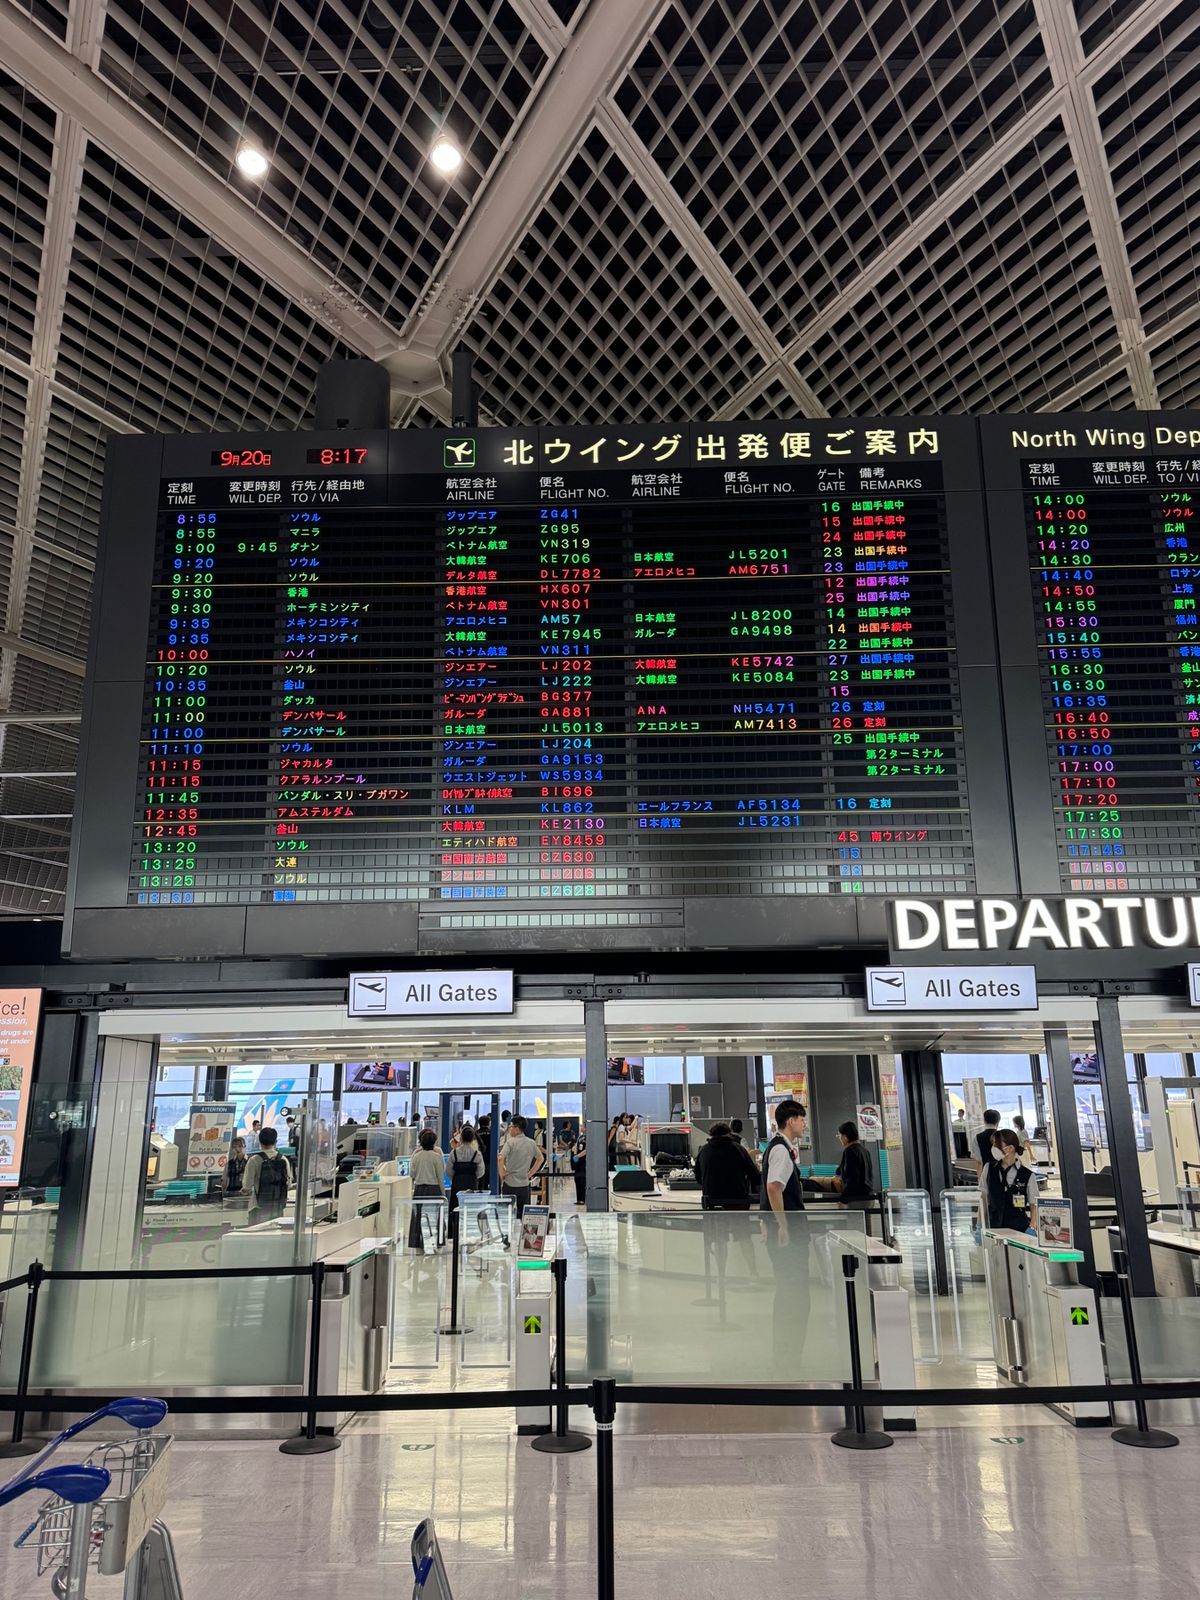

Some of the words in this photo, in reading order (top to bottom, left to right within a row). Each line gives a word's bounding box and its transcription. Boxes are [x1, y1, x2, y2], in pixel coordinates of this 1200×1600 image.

[1012, 430, 1075, 447] North
[1086, 429, 1144, 449] Wing
[504, 434, 682, 465] 北ウイング
[697, 428, 939, 461] 出発便ご案内
[221, 451, 271, 466] 9月20日
[321, 449, 367, 464] 8:17
[1029, 463, 1054, 473] 定刻
[1092, 461, 1144, 472] 変更時刻
[724, 472, 749, 482] 便名
[818, 469, 844, 479] ゲート
[860, 468, 884, 478] 備考
[1158, 474, 1175, 482] TO
[446, 478, 497, 488] 航空会社
[540, 477, 564, 487] 便名
[632, 473, 682, 485] 航空会社
[861, 479, 921, 489] REMARKS
[1030, 476, 1060, 485] TIME
[1094, 475, 1121, 484] WILL
[1124, 475, 1148, 483] DEP.
[168, 483, 194, 493] 定刻
[230, 481, 280, 492] 変更時刻
[632, 487, 680, 496] AIRLINE
[725, 484, 769, 494] FLIGHT
[774, 483, 794, 493] NO.
[819, 482, 845, 491] GATE
[229, 492, 256, 503] WILL
[259, 492, 281, 503] DEP.
[292, 493, 308, 502] TO
[319, 492, 339, 501] VIA
[447, 491, 494, 500] AIRLINE
[541, 489, 584, 498] FLIGHT
[588, 488, 608, 498] NO.
[1161, 493, 1191, 502] ソウル
[167, 494, 195, 504] TIME
[1034, 495, 1084, 505] 14:00
[822, 502, 840, 512] 16
[852, 500, 904, 510] 出国手続中
[178, 514, 216, 524] 8:55
[541, 509, 578, 519] ZG41
[823, 517, 840, 527] 15
[290, 528, 320, 536] マニラ
[541, 524, 579, 533] ZG95
[1037, 525, 1087, 535] 14:20
[1165, 523, 1184, 532] 広州
[823, 532, 841, 542] 24
[176, 544, 214, 553] 9:00
[238, 543, 277, 552] 9:45
[290, 543, 319, 551] ダナン
[447, 541, 507, 550] ベトナム航空
[541, 539, 589, 548] VN319
[729, 549, 787, 559] JL5201
[855, 545, 906, 555] 出国手続中
[541, 554, 590, 563] KE706
[634, 552, 673, 561] 日本航空
[1040, 555, 1091, 565] 14:30
[175, 558, 213, 568] 9:20
[290, 558, 319, 567] ソウル
[541, 569, 600, 578] DL7782
[635, 568, 695, 576] アエロメヒコ
[730, 564, 788, 574] AM6751
[446, 571, 496, 580] デルタ航空
[826, 578, 843, 587] 12
[172, 589, 211, 598] 9:30
[288, 588, 308, 597] 香港
[446, 586, 486, 595] 香港航空
[541, 584, 590, 594] HX607
[1043, 586, 1094, 596] 14:50
[1173, 584, 1193, 593] 上海
[826, 593, 844, 603] 25
[541, 599, 588, 609] VN301
[541, 615, 580, 624] AM57
[731, 610, 791, 620] JL8200
[170, 619, 209, 629] 9:35
[446, 617, 506, 625] アエロメヒコ
[1047, 617, 1097, 627] 15:30
[541, 629, 601, 639] KE7945
[635, 628, 676, 638] ガルーダ
[731, 625, 792, 636] GA9498
[828, 639, 847, 649] 22
[159, 650, 208, 660] 10:00
[1049, 648, 1101, 659] 15:55
[542, 661, 591, 670] LJ202
[732, 656, 793, 667] KE5742
[156, 664, 207, 675] 10:20
[445, 663, 496, 671] ジンエアー
[156, 681, 206, 691] 10:35
[284, 680, 304, 690] 釜山
[542, 676, 591, 686] LJ222
[284, 696, 314, 705] ダッカ
[542, 692, 591, 701] BG377
[1054, 696, 1106, 707] 16:35
[154, 697, 205, 707] 11:00
[832, 702, 851, 712] 26
[863, 702, 884, 711] 定刻
[638, 706, 666, 714] ANA
[734, 703, 794, 713] NH5471
[283, 711, 346, 720] デンパサール
[445, 709, 486, 718] ガルーダ
[542, 722, 603, 732] JL5013
[735, 719, 796, 729] AM7413
[445, 725, 486, 735] 日本航空
[866, 732, 919, 743] 出国手続中
[150, 744, 202, 754] 11:10
[281, 743, 312, 752] ソウル
[866, 749, 943, 759] 第2ターミナル
[280, 759, 333, 768] ジャカルタ
[542, 754, 603, 765] GA9153
[150, 760, 200, 770] 11:15
[280, 774, 365, 784] クアラルンプール
[443, 772, 526, 782] ウエストジェット
[541, 771, 602, 780] WS5934
[147, 792, 198, 803] 11:45
[1064, 794, 1117, 805] 17:20
[444, 805, 474, 813] KLM
[542, 802, 593, 813] KL862
[639, 801, 712, 811] エールフランス
[738, 800, 800, 810] AF5134
[146, 809, 198, 819] 12:35
[278, 807, 353, 816] アムステルダム
[145, 825, 196, 836] 12:45
[277, 824, 298, 834] 釜山
[144, 842, 195, 853] 13:20
[894, 897, 1200, 950] DEPARTU
[406, 984, 431, 1002] All
[439, 984, 497, 1002] Gates
[926, 980, 951, 997] All
[959, 979, 1020, 997] Gates
[0, 996, 26, 1016] ce!
